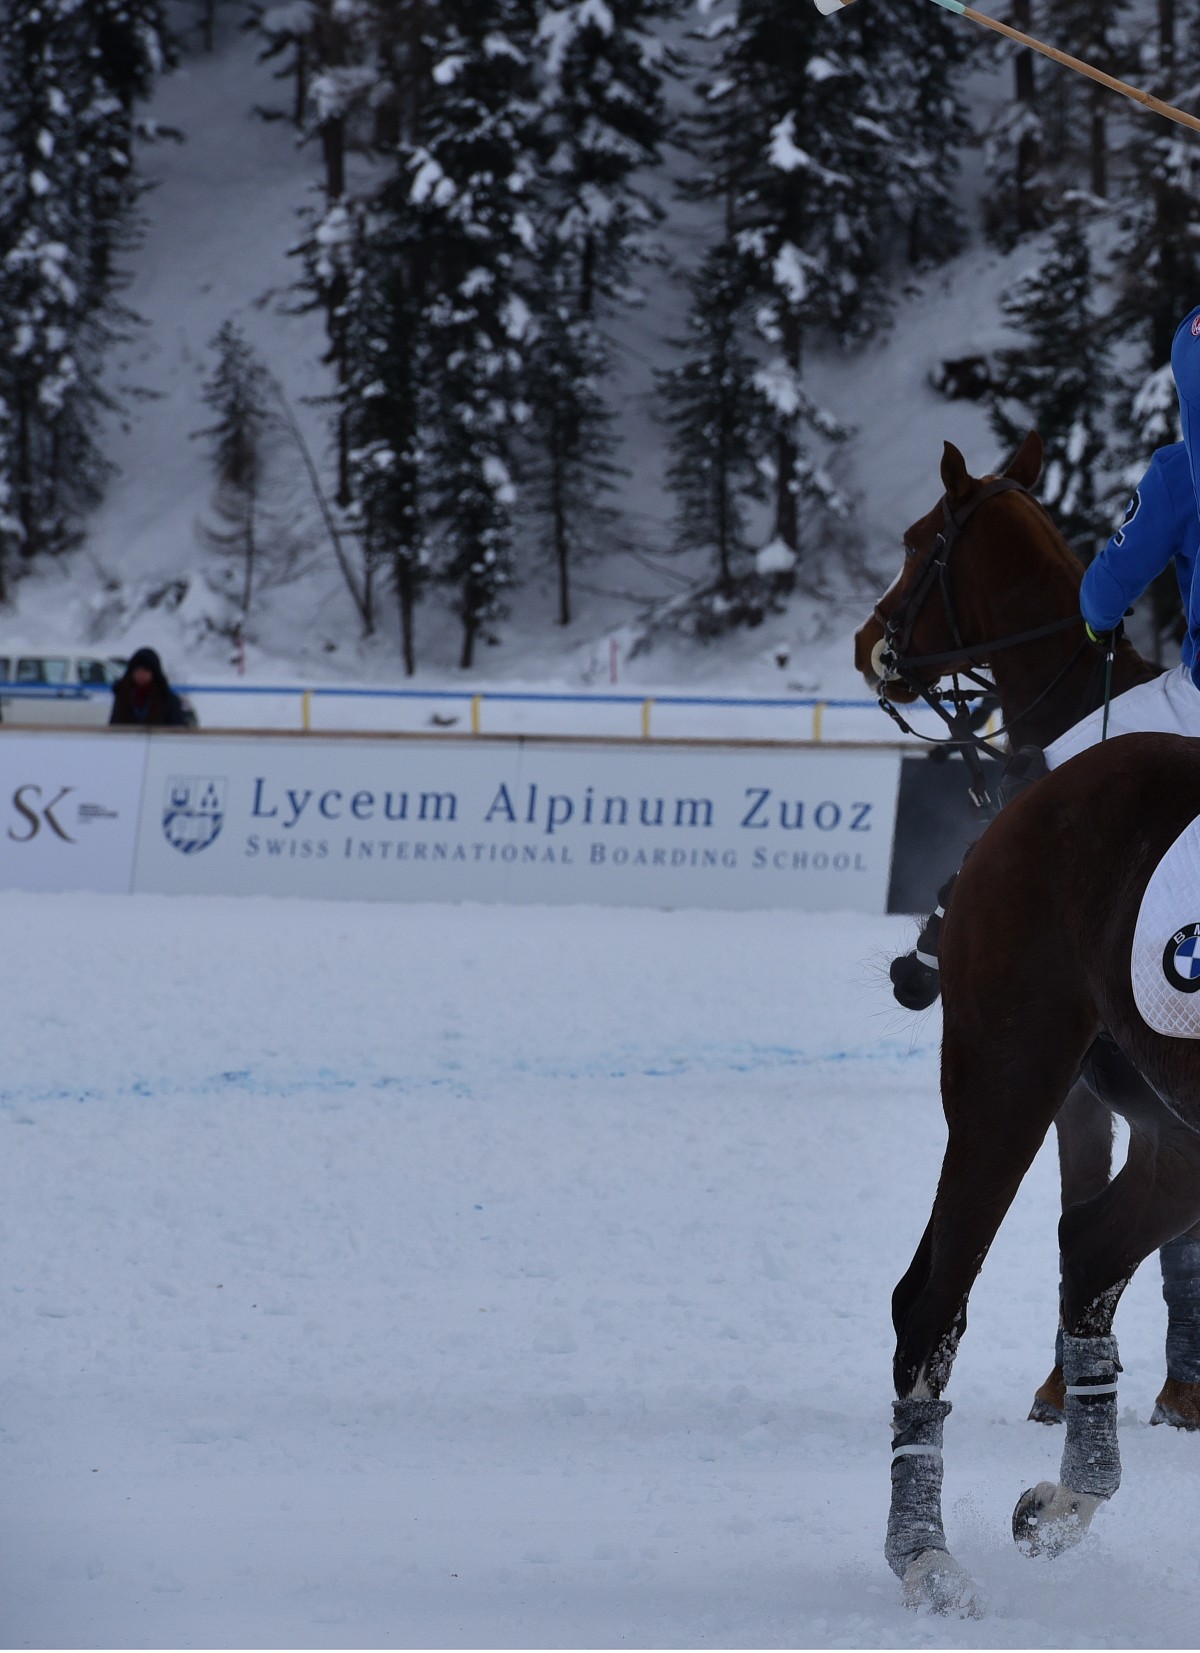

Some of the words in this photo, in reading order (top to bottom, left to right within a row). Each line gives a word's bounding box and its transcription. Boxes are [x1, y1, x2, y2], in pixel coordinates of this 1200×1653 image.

[7, 783, 78, 845] SK
[250, 777, 460, 828] Lyceum
[483, 782, 715, 835] Alpinum
[740, 787, 874, 833] Zuoz
[244, 834, 331, 858] SWISS
[344, 836, 575, 866] INTERNATIONAL
[589, 842, 738, 869] BOARDING
[751, 845, 868, 872] SCHOOL
